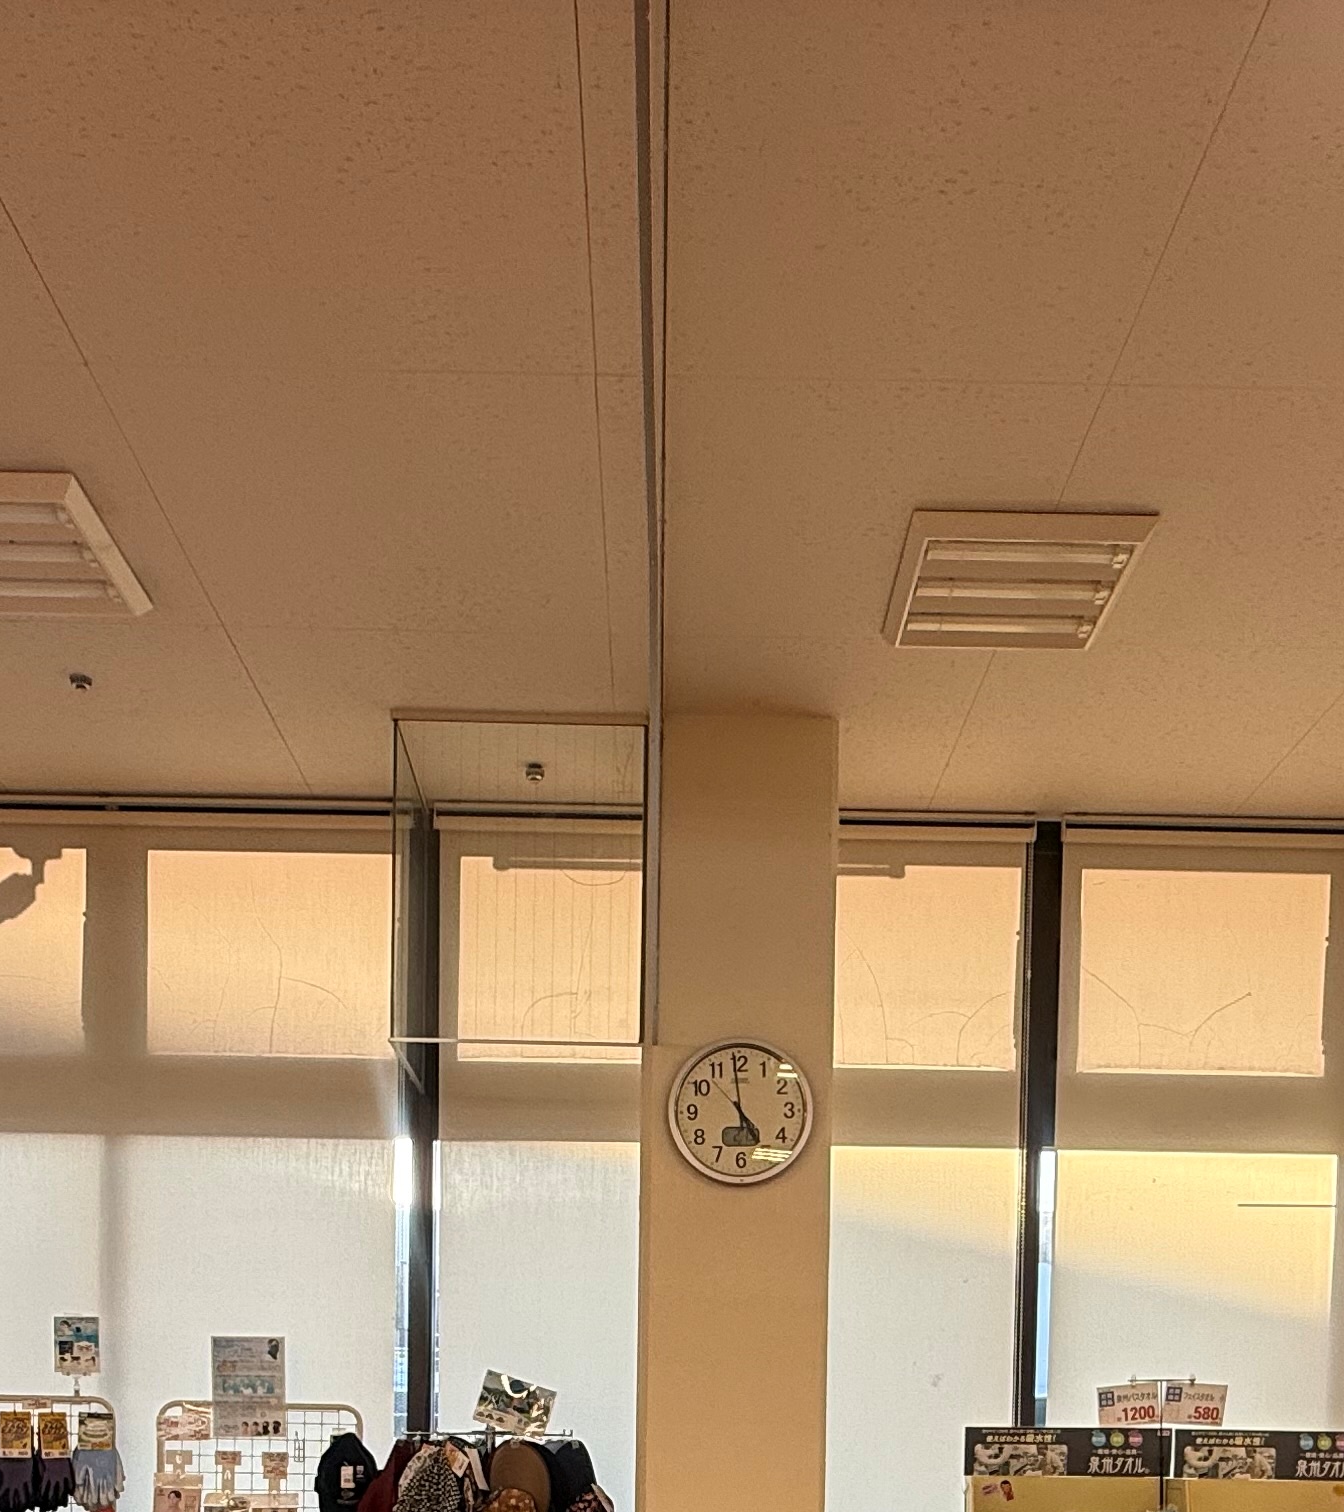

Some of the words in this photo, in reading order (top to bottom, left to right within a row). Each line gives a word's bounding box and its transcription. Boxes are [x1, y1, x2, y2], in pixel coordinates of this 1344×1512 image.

[709, 1061, 723, 1079] 11
[759, 1061, 767, 1078] 1
[692, 1079, 711, 1097] 10
[776, 1079, 788, 1095] 2
[686, 1103, 698, 1121] 9
[783, 1101, 795, 1119] 3
[693, 1128, 706, 1146] 8
[775, 1126, 788, 1143] 4
[712, 1145, 723, 1163] 7
[735, 1151, 747, 1169] 6
[1121, 1405, 1156, 1422] 1200
[1193, 1405, 1220, 1421] 580
